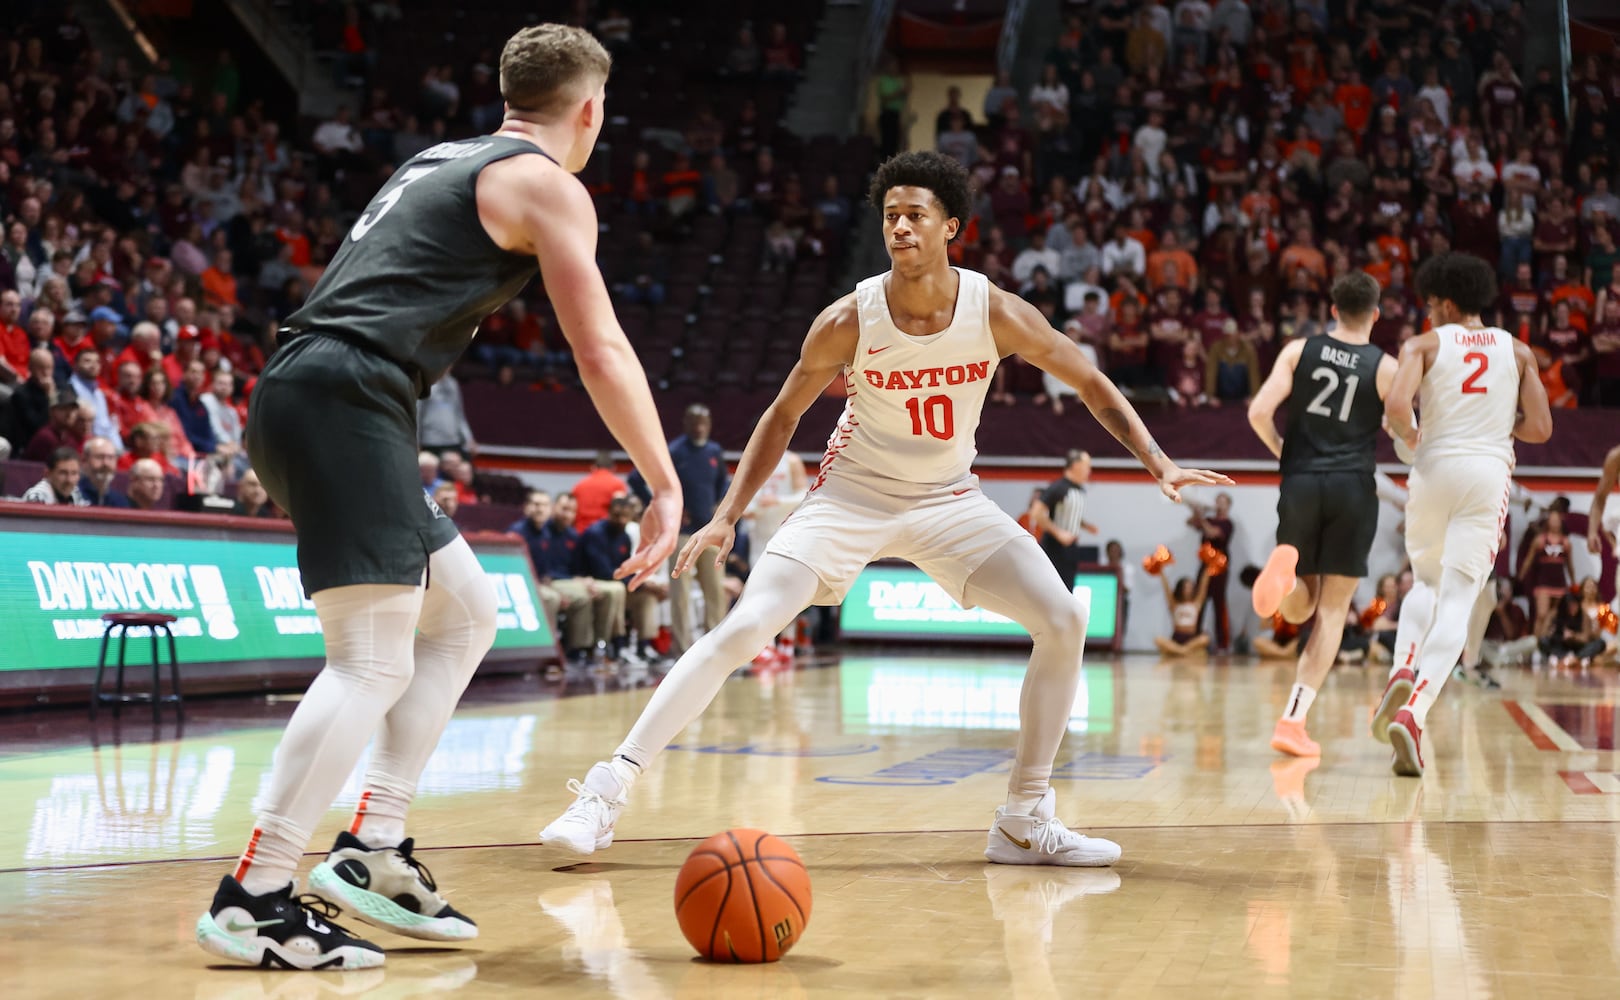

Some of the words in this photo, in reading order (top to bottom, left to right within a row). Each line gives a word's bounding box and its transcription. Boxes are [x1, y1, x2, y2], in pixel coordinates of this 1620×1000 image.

[863, 360, 990, 390] DAYTON
[1320, 344, 1361, 369] BASILE
[1462, 351, 1489, 394] 2
[1306, 366, 1360, 422] 21
[905, 394, 954, 440] 10
[27, 561, 194, 610] DAVENPORT
